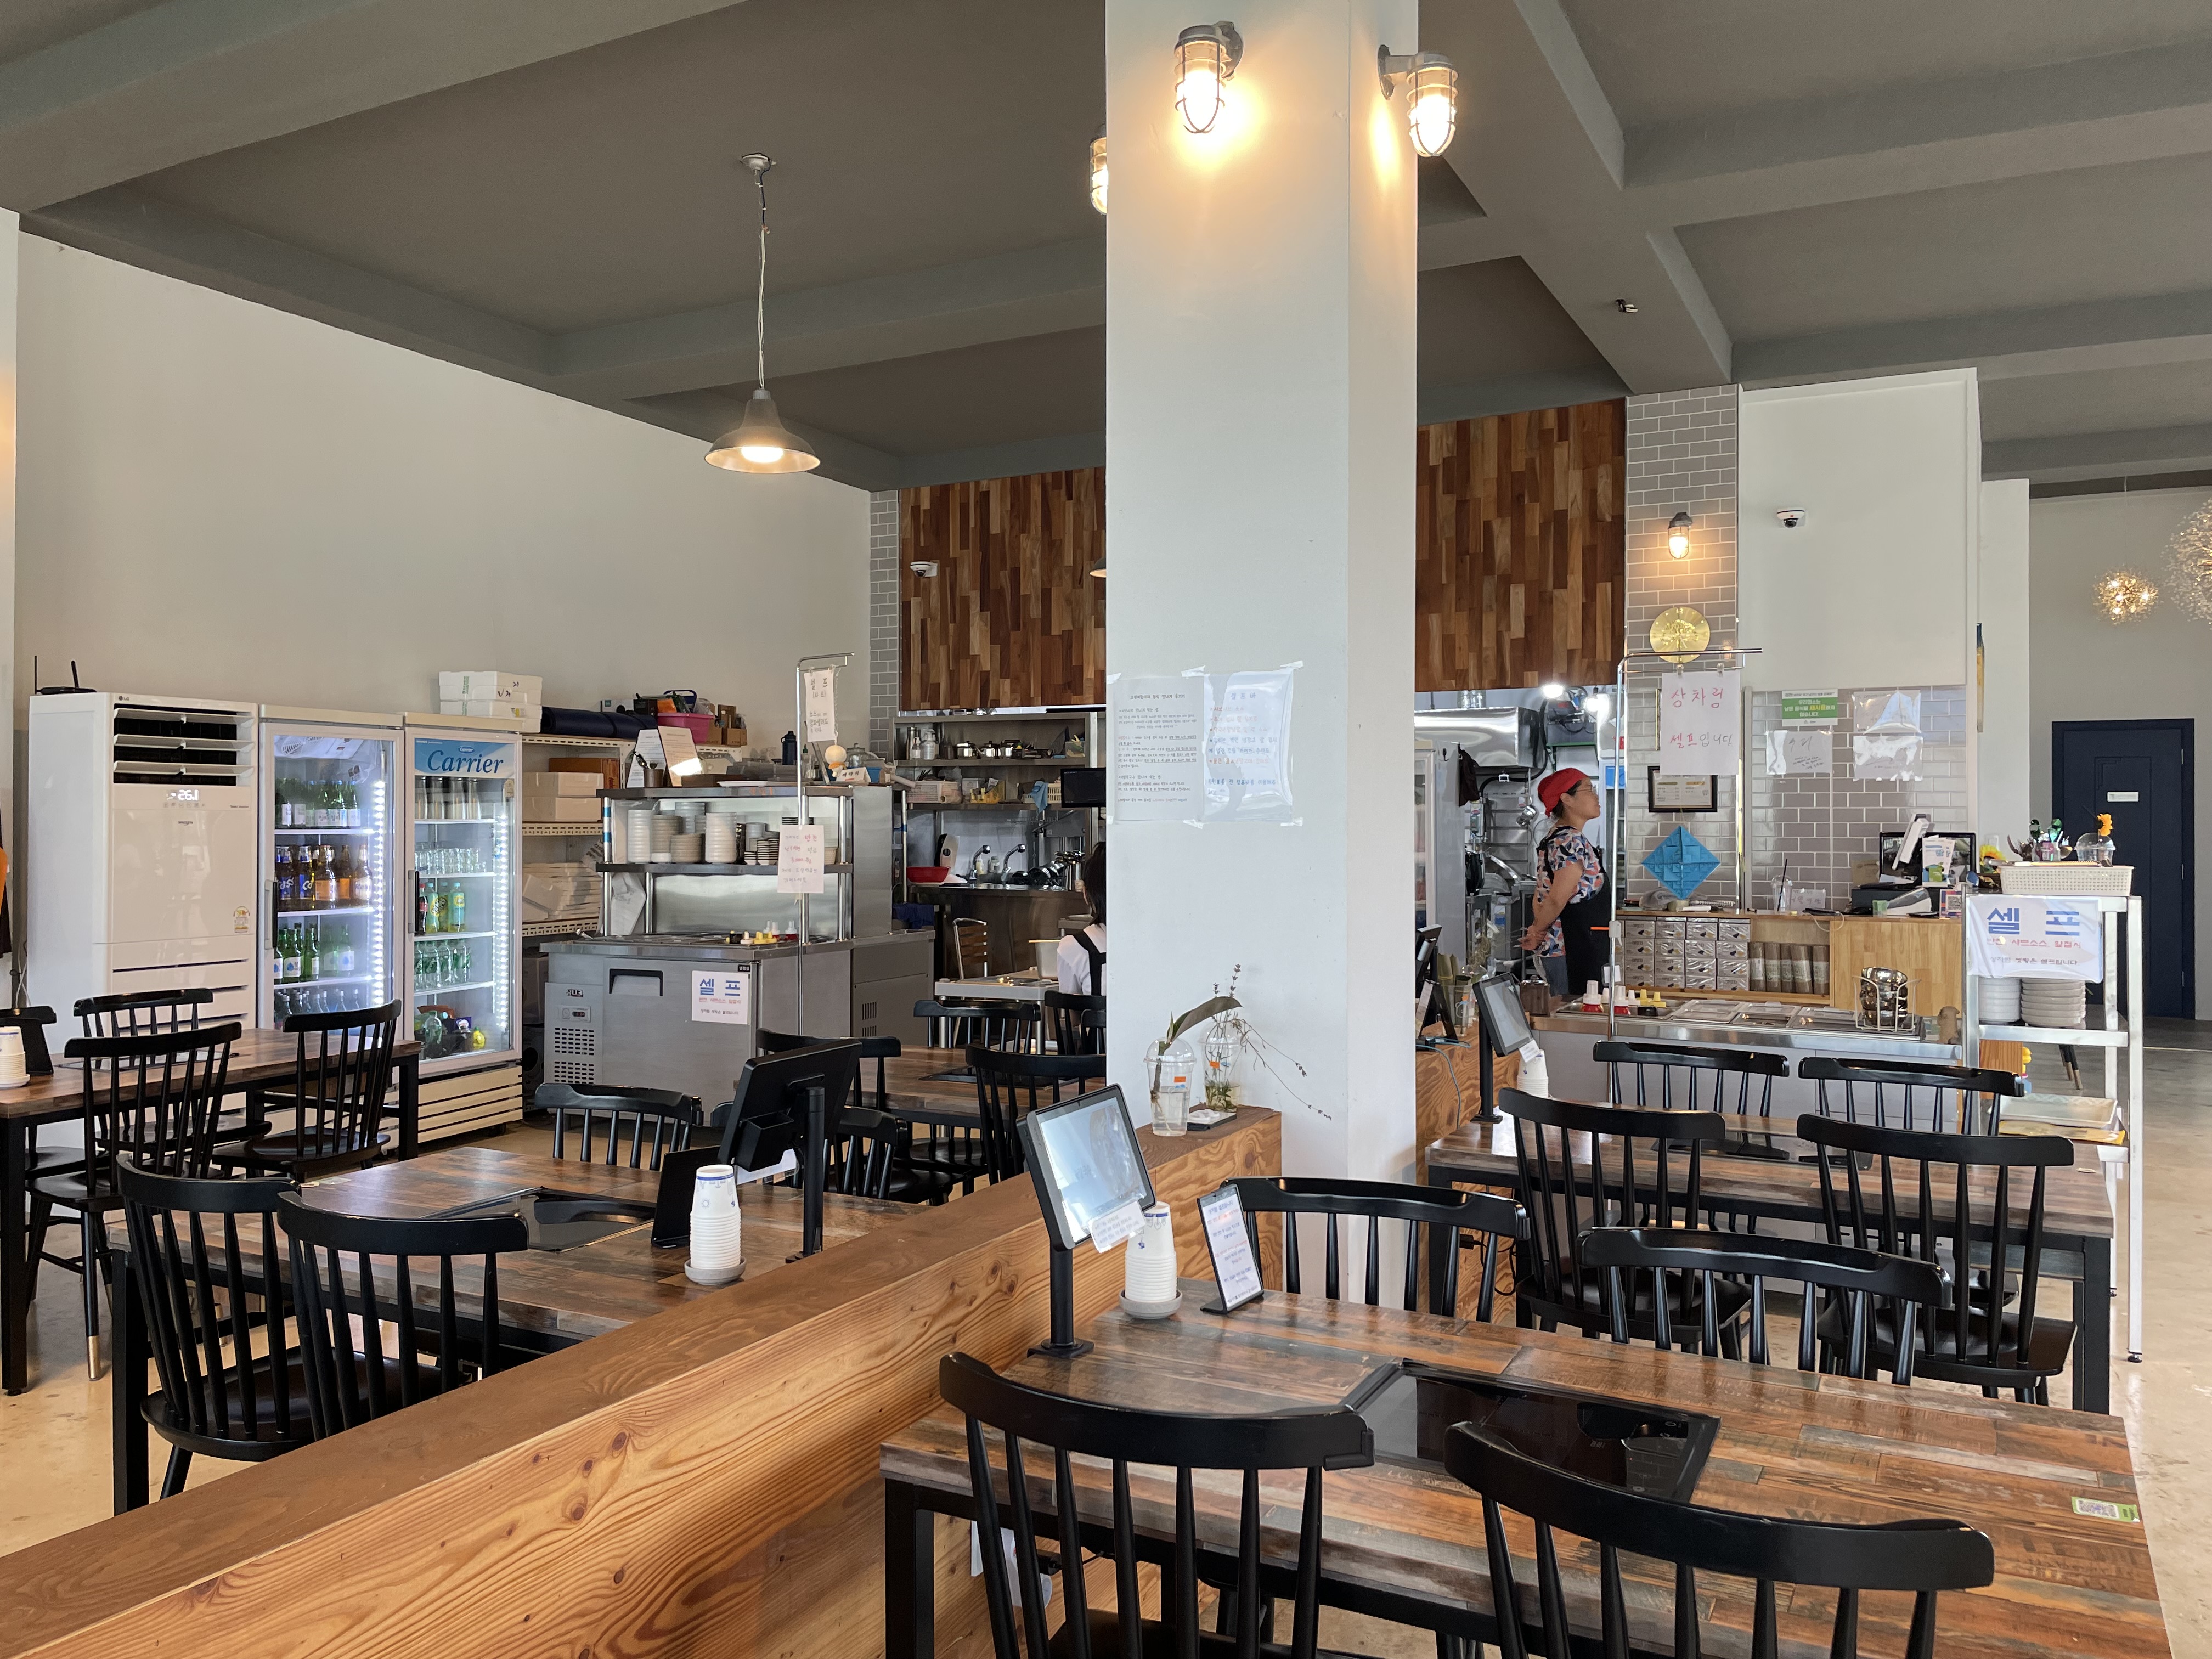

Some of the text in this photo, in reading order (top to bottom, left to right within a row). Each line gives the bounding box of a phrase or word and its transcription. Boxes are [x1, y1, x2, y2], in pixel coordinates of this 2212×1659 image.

[1671, 687, 1723, 708] 상차림
[1670, 732, 1733, 749] 셀프입니다
[427, 750, 504, 774] Carrier
